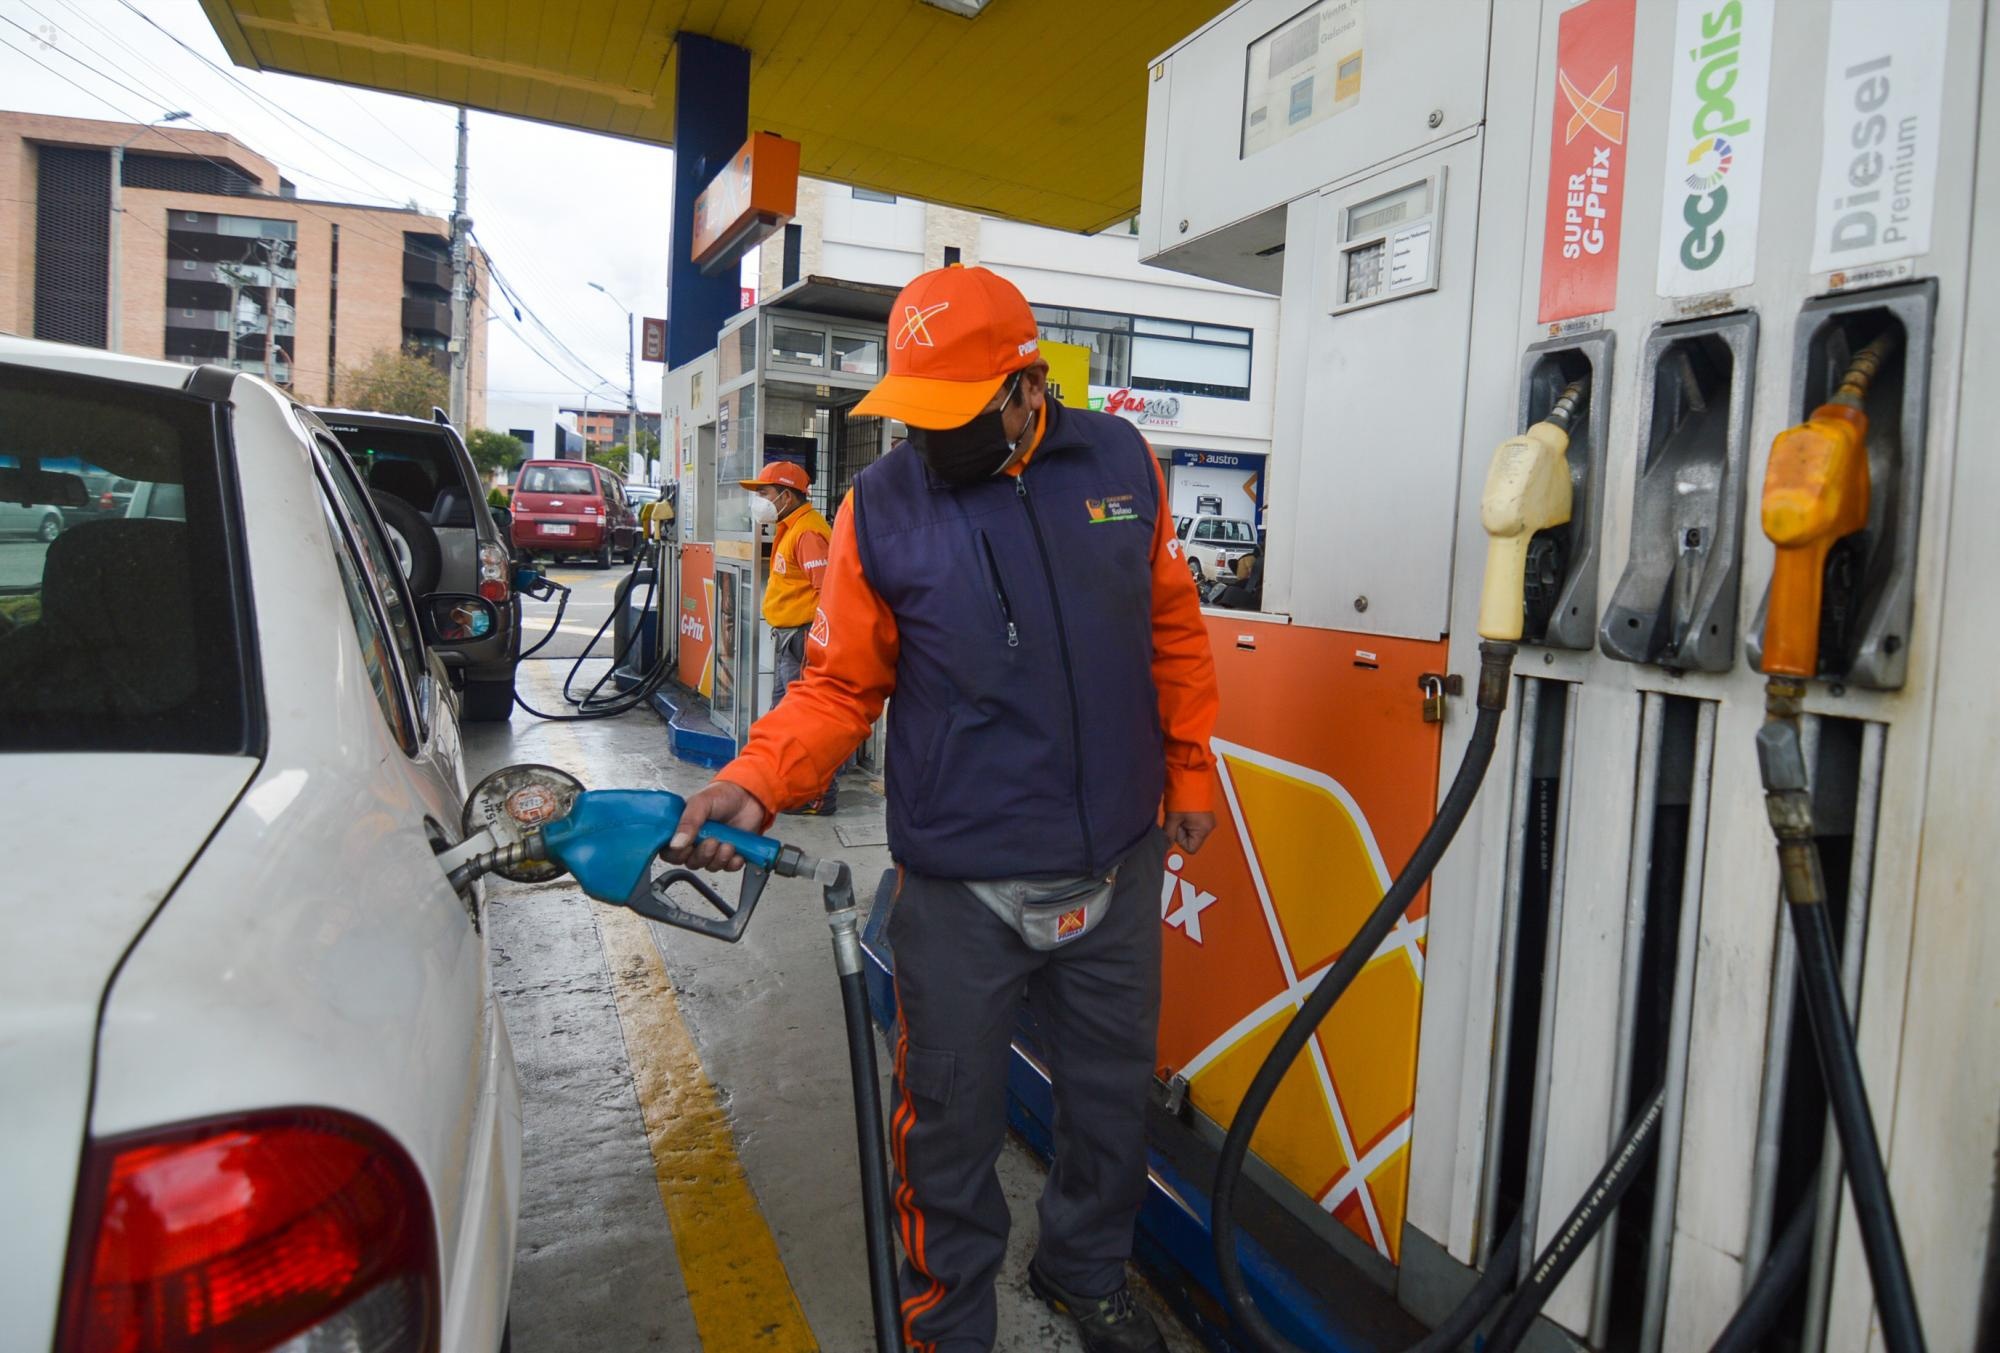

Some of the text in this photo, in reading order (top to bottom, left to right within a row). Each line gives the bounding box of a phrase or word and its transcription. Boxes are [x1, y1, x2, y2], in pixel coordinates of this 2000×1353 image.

[1582, 146, 1611, 255] G-Prix
[1830, 54, 1892, 254] Diesel
[1883, 115, 1918, 244] Premium
[1562, 173, 1586, 259] SUPER
[1206, 454, 1239, 465] austro
